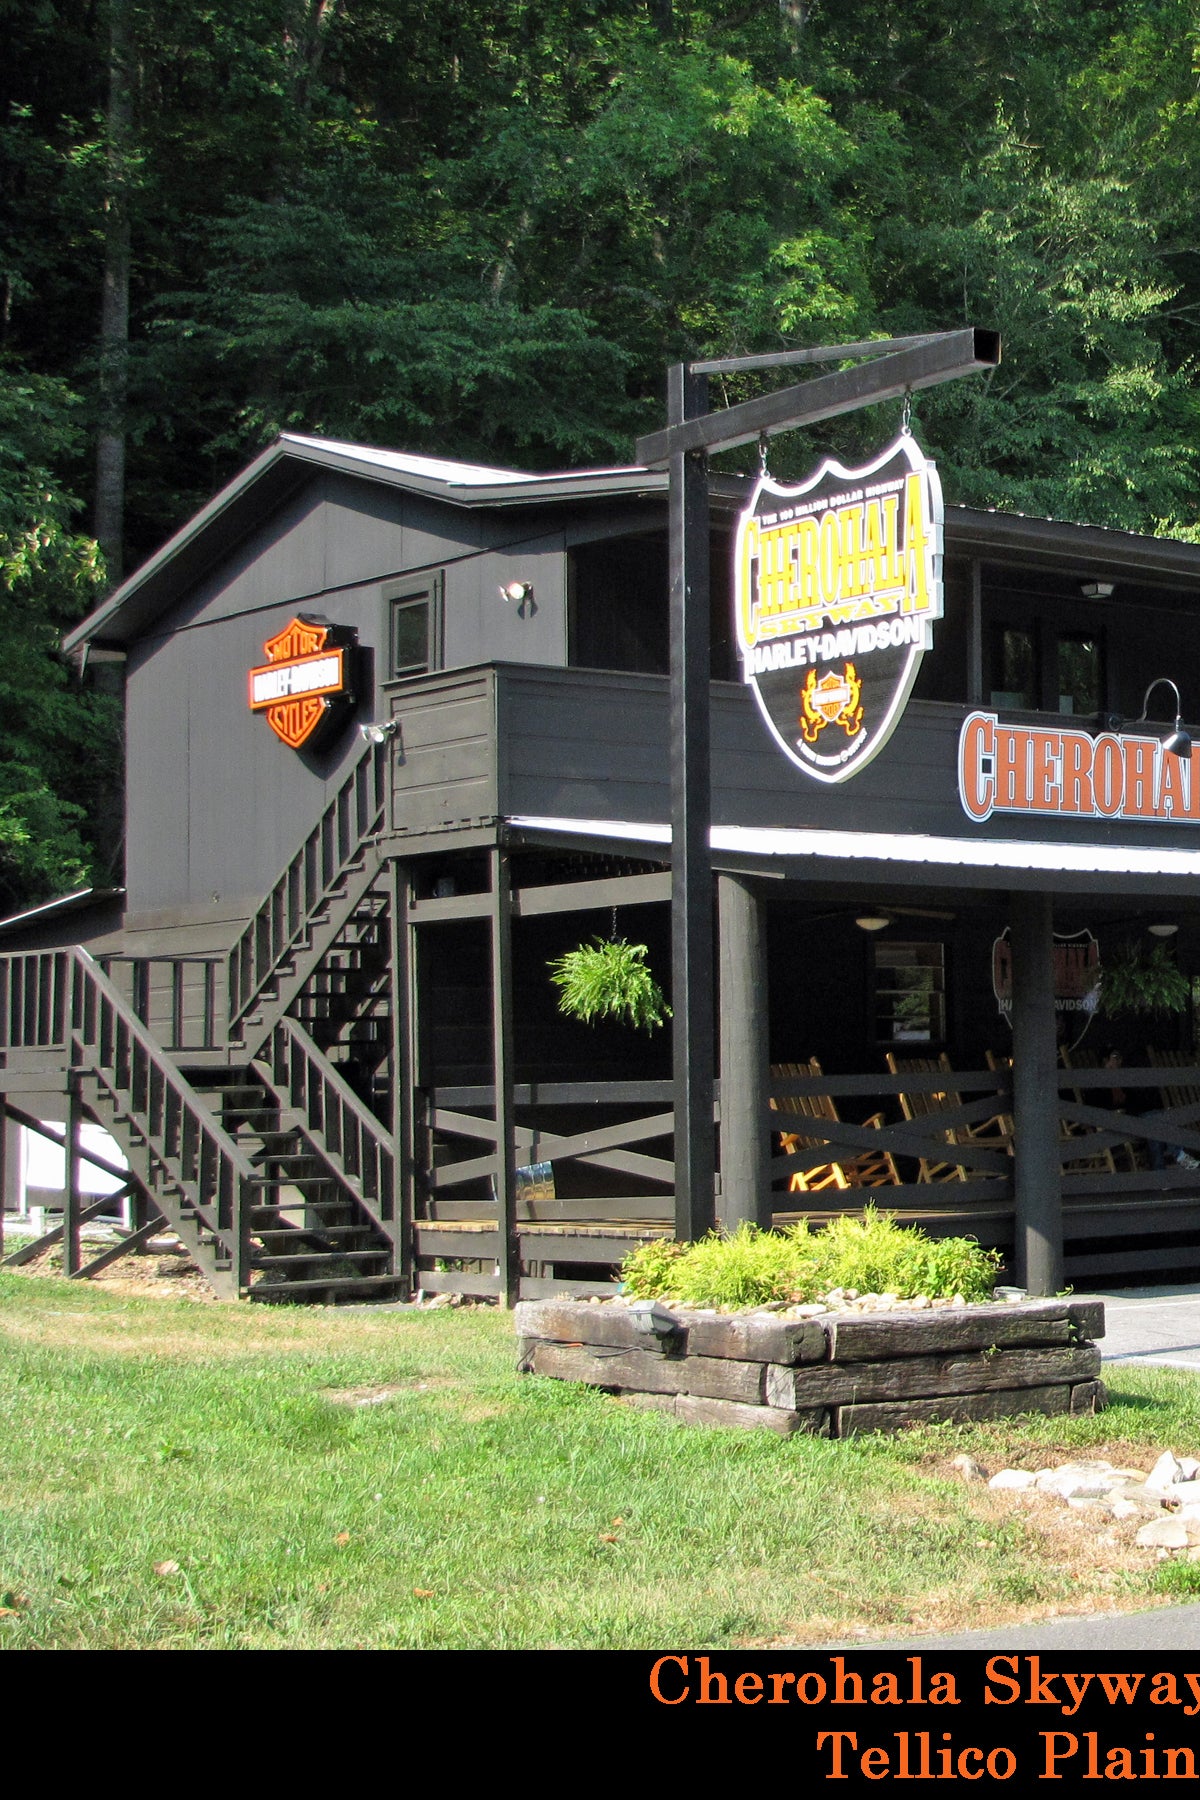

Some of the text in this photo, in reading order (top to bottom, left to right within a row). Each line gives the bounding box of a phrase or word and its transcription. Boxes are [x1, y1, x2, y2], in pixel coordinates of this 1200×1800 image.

[739, 472, 931, 647] CHEROHALA
[760, 594, 898, 638] SKYWAY
[273, 625, 319, 661] MOTOR
[752, 616, 920, 673] HARLEY-DAVIDSON
[274, 697, 319, 739] CYCLES
